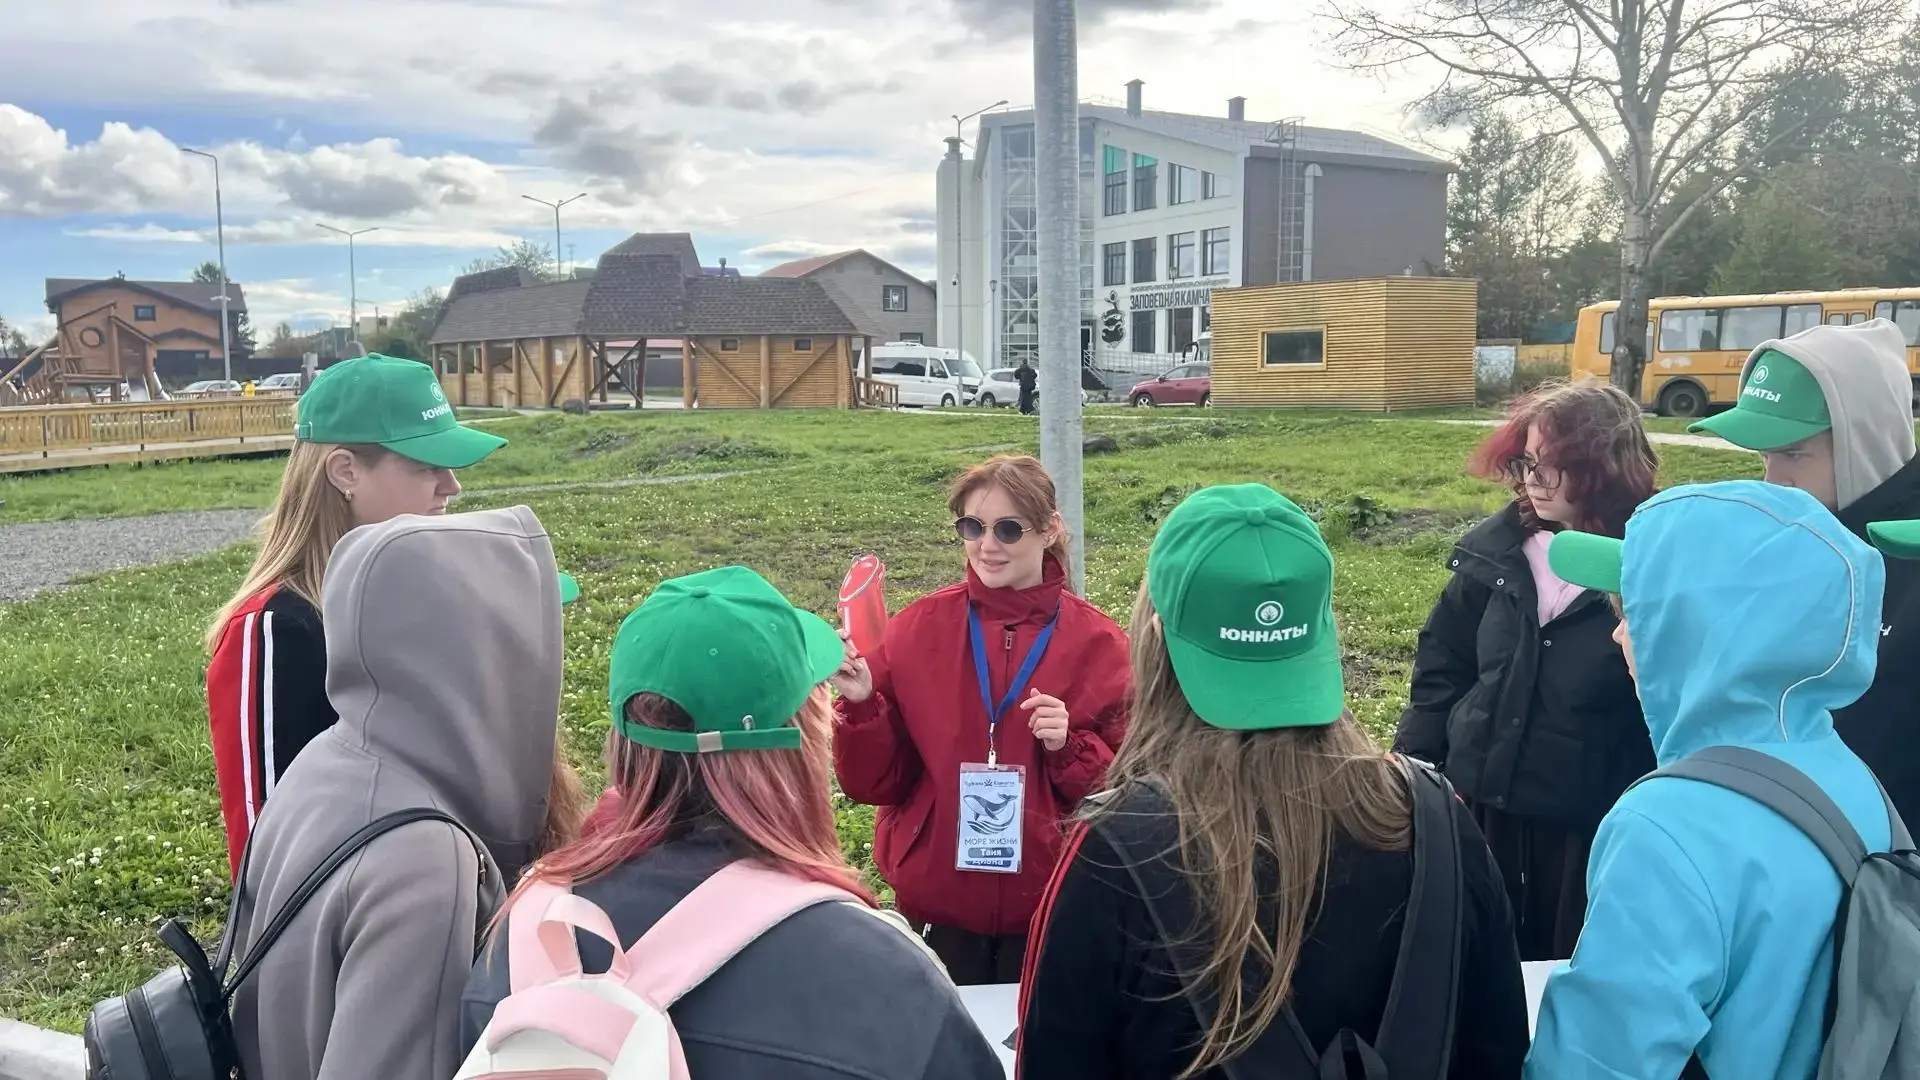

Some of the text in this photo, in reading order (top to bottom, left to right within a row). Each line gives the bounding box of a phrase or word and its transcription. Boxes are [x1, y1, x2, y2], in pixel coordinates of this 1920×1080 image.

[1130, 290, 1180, 310] ЗАПОВЕДНАЯ
[1220, 623, 1308, 642] ЮННАТЫ
[964, 838, 1018, 846] МОРЕ ЖИЗНИ
[980, 848, 1002, 857] Таня
